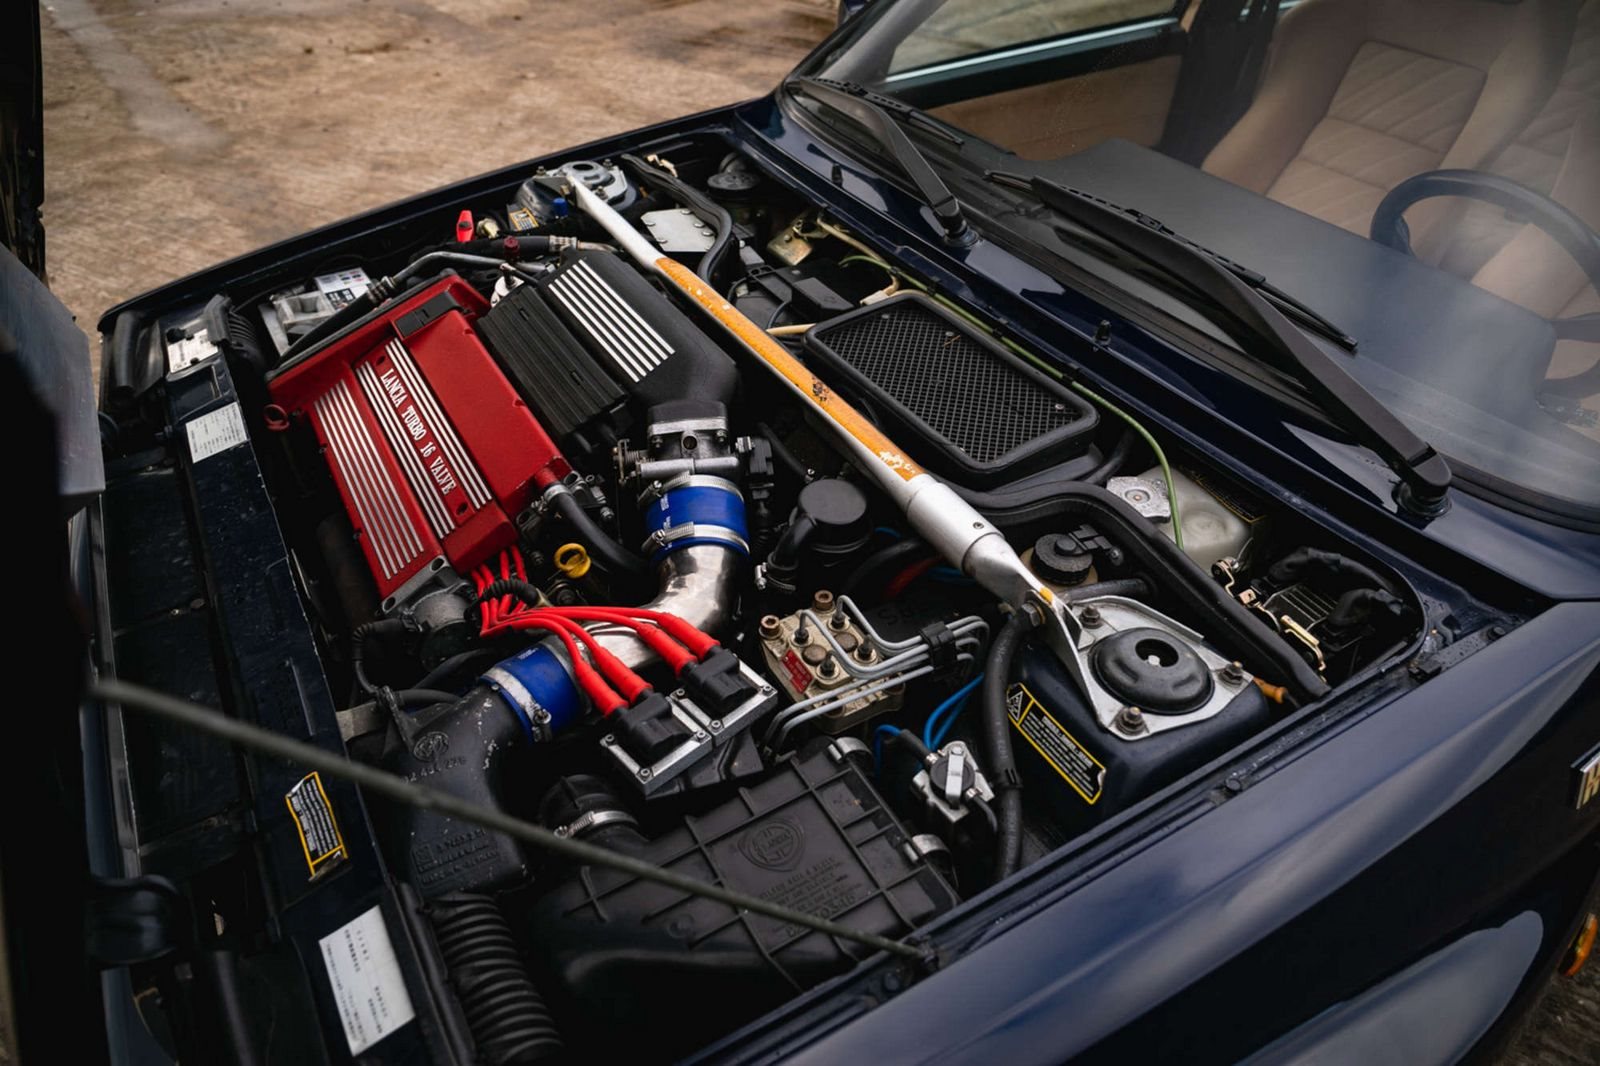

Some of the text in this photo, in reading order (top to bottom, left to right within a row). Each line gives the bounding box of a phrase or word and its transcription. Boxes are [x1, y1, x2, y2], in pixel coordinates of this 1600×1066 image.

[380, 368, 457, 495] LANCIA TURBO 16 VALVE
